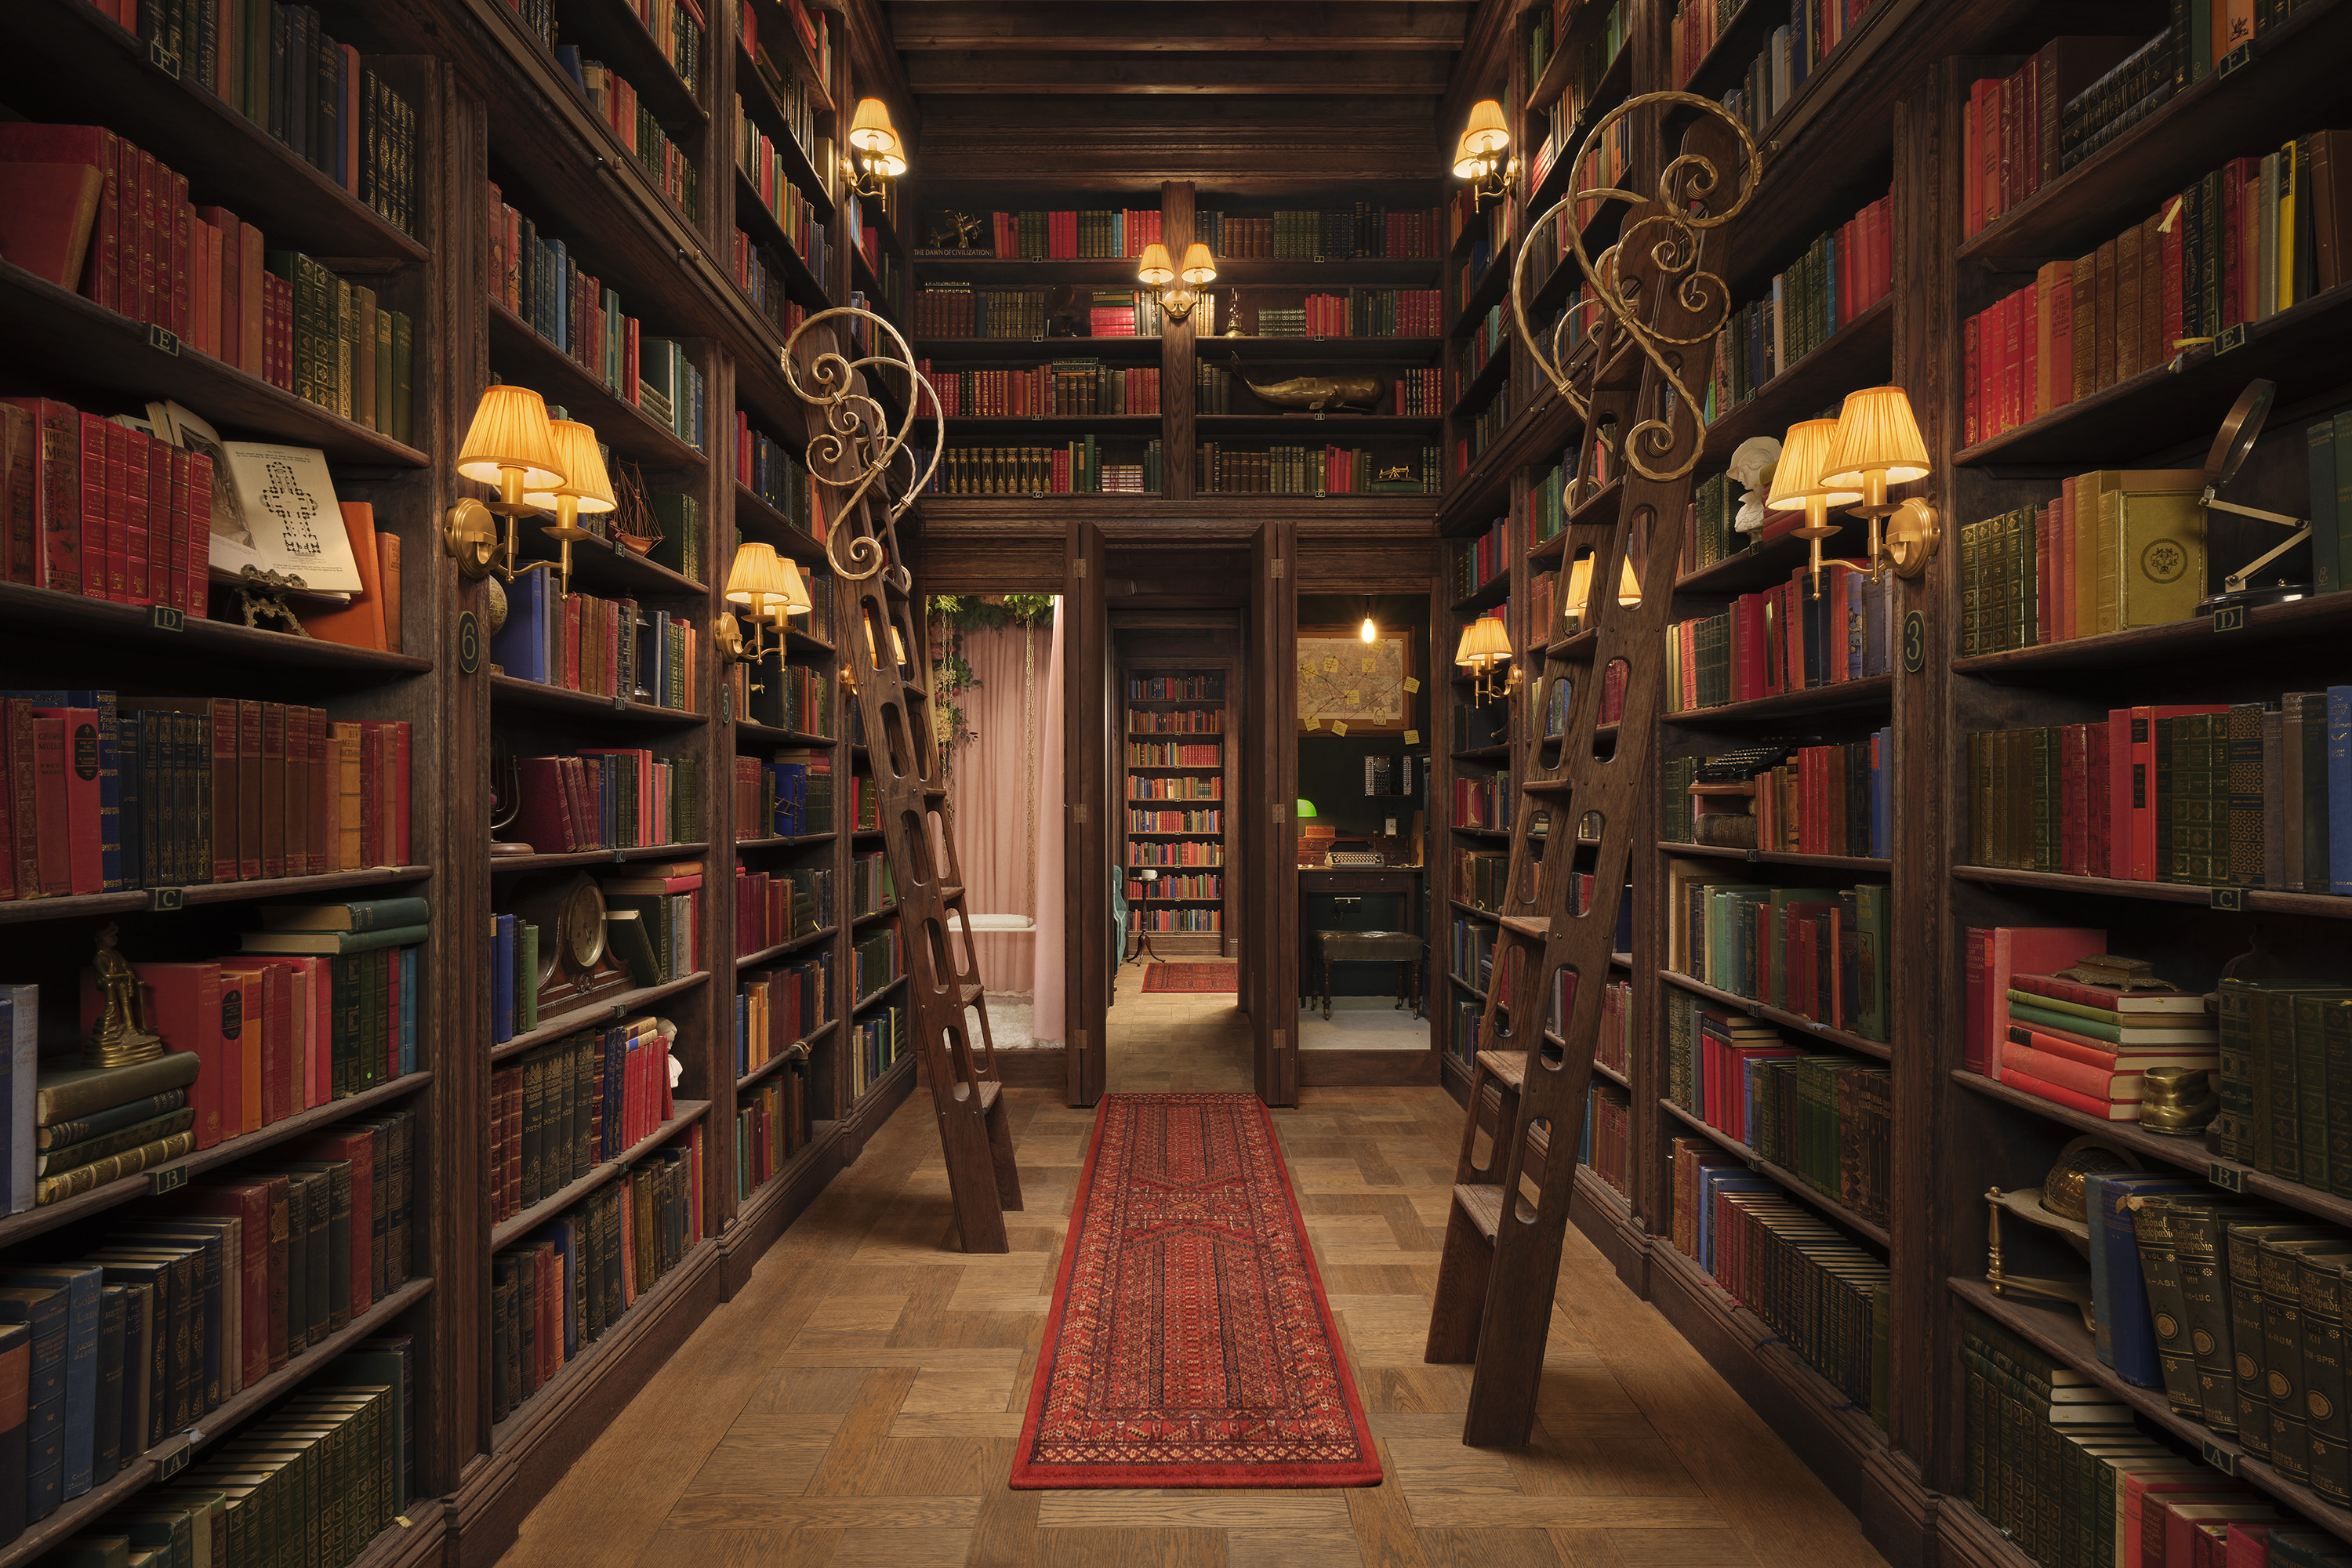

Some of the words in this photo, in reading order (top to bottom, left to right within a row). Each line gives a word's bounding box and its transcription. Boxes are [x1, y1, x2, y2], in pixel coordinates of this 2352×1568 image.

[159, 49, 171, 68] F
[2227, 50, 2239, 71] F
[2052, 298, 2071, 310] SECRET
[2052, 317, 2070, 328] HOUSE
[159, 330, 171, 350] E
[2221, 330, 2234, 350] E
[45, 429, 63, 445] THE
[163, 609, 176, 627] D
[2220, 612, 2234, 629] D
[463, 622, 475, 659] 6
[1907, 620, 1920, 660] 3
[724, 692, 729, 715] 5
[163, 891, 176, 907] C
[2220, 891, 2233, 907] C
[166, 1170, 178, 1189] B
[2218, 1167, 2230, 1187] B
[2183, 1266, 2198, 1276] VOL
[73, 1292, 100, 1309] Golde
[2234, 1289, 2249, 1300] VOL
[2266, 1305, 2282, 1317] VOL
[2307, 1322, 2323, 1334] VOL
[169, 1454, 182, 1473] A
[2211, 1448, 2224, 1468] A
